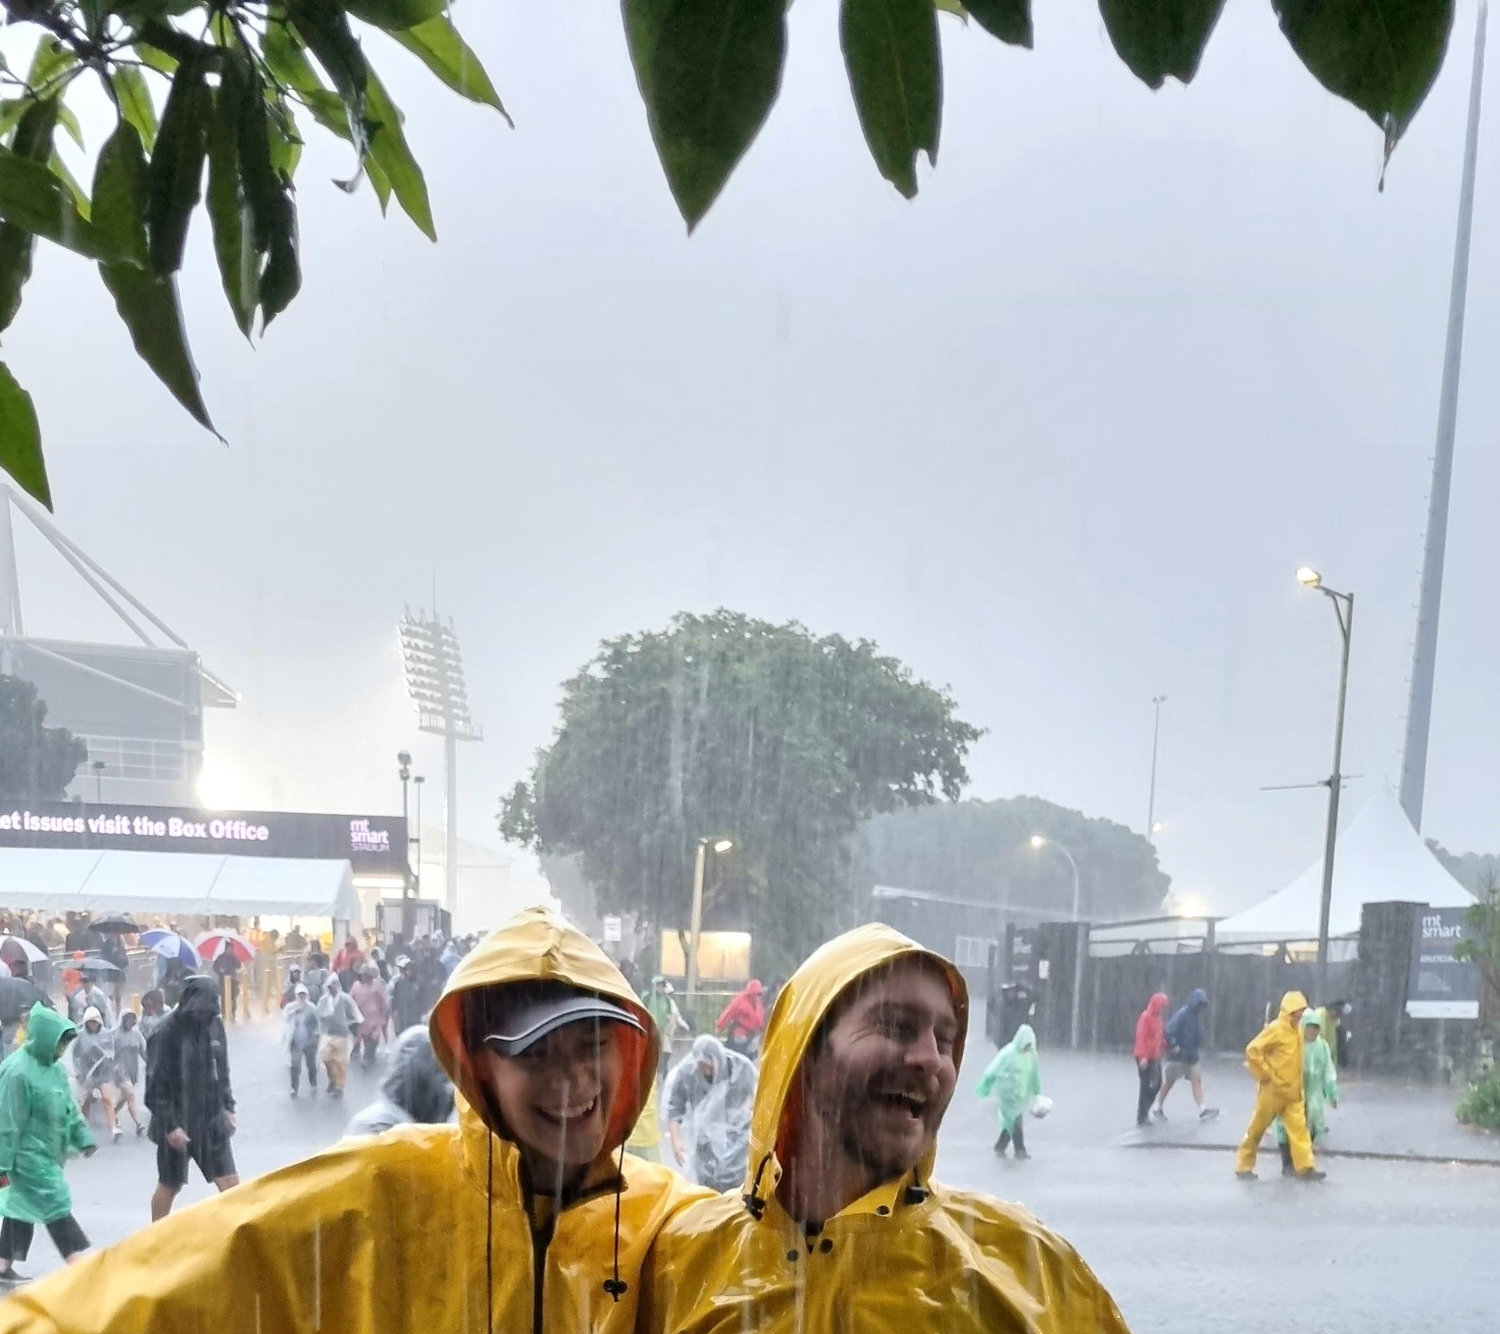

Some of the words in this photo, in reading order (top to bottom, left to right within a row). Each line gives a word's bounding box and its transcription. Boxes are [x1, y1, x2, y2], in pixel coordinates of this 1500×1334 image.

[24, 811, 85, 833] issues
[88, 814, 131, 835] visit
[133, 816, 166, 836] the
[168, 817, 208, 838] Box
[209, 820, 269, 840] Office
[350, 819, 369, 832] mt
[350, 830, 389, 844] smart
[1422, 914, 1441, 927] mt
[1422, 925, 1462, 938] smart
